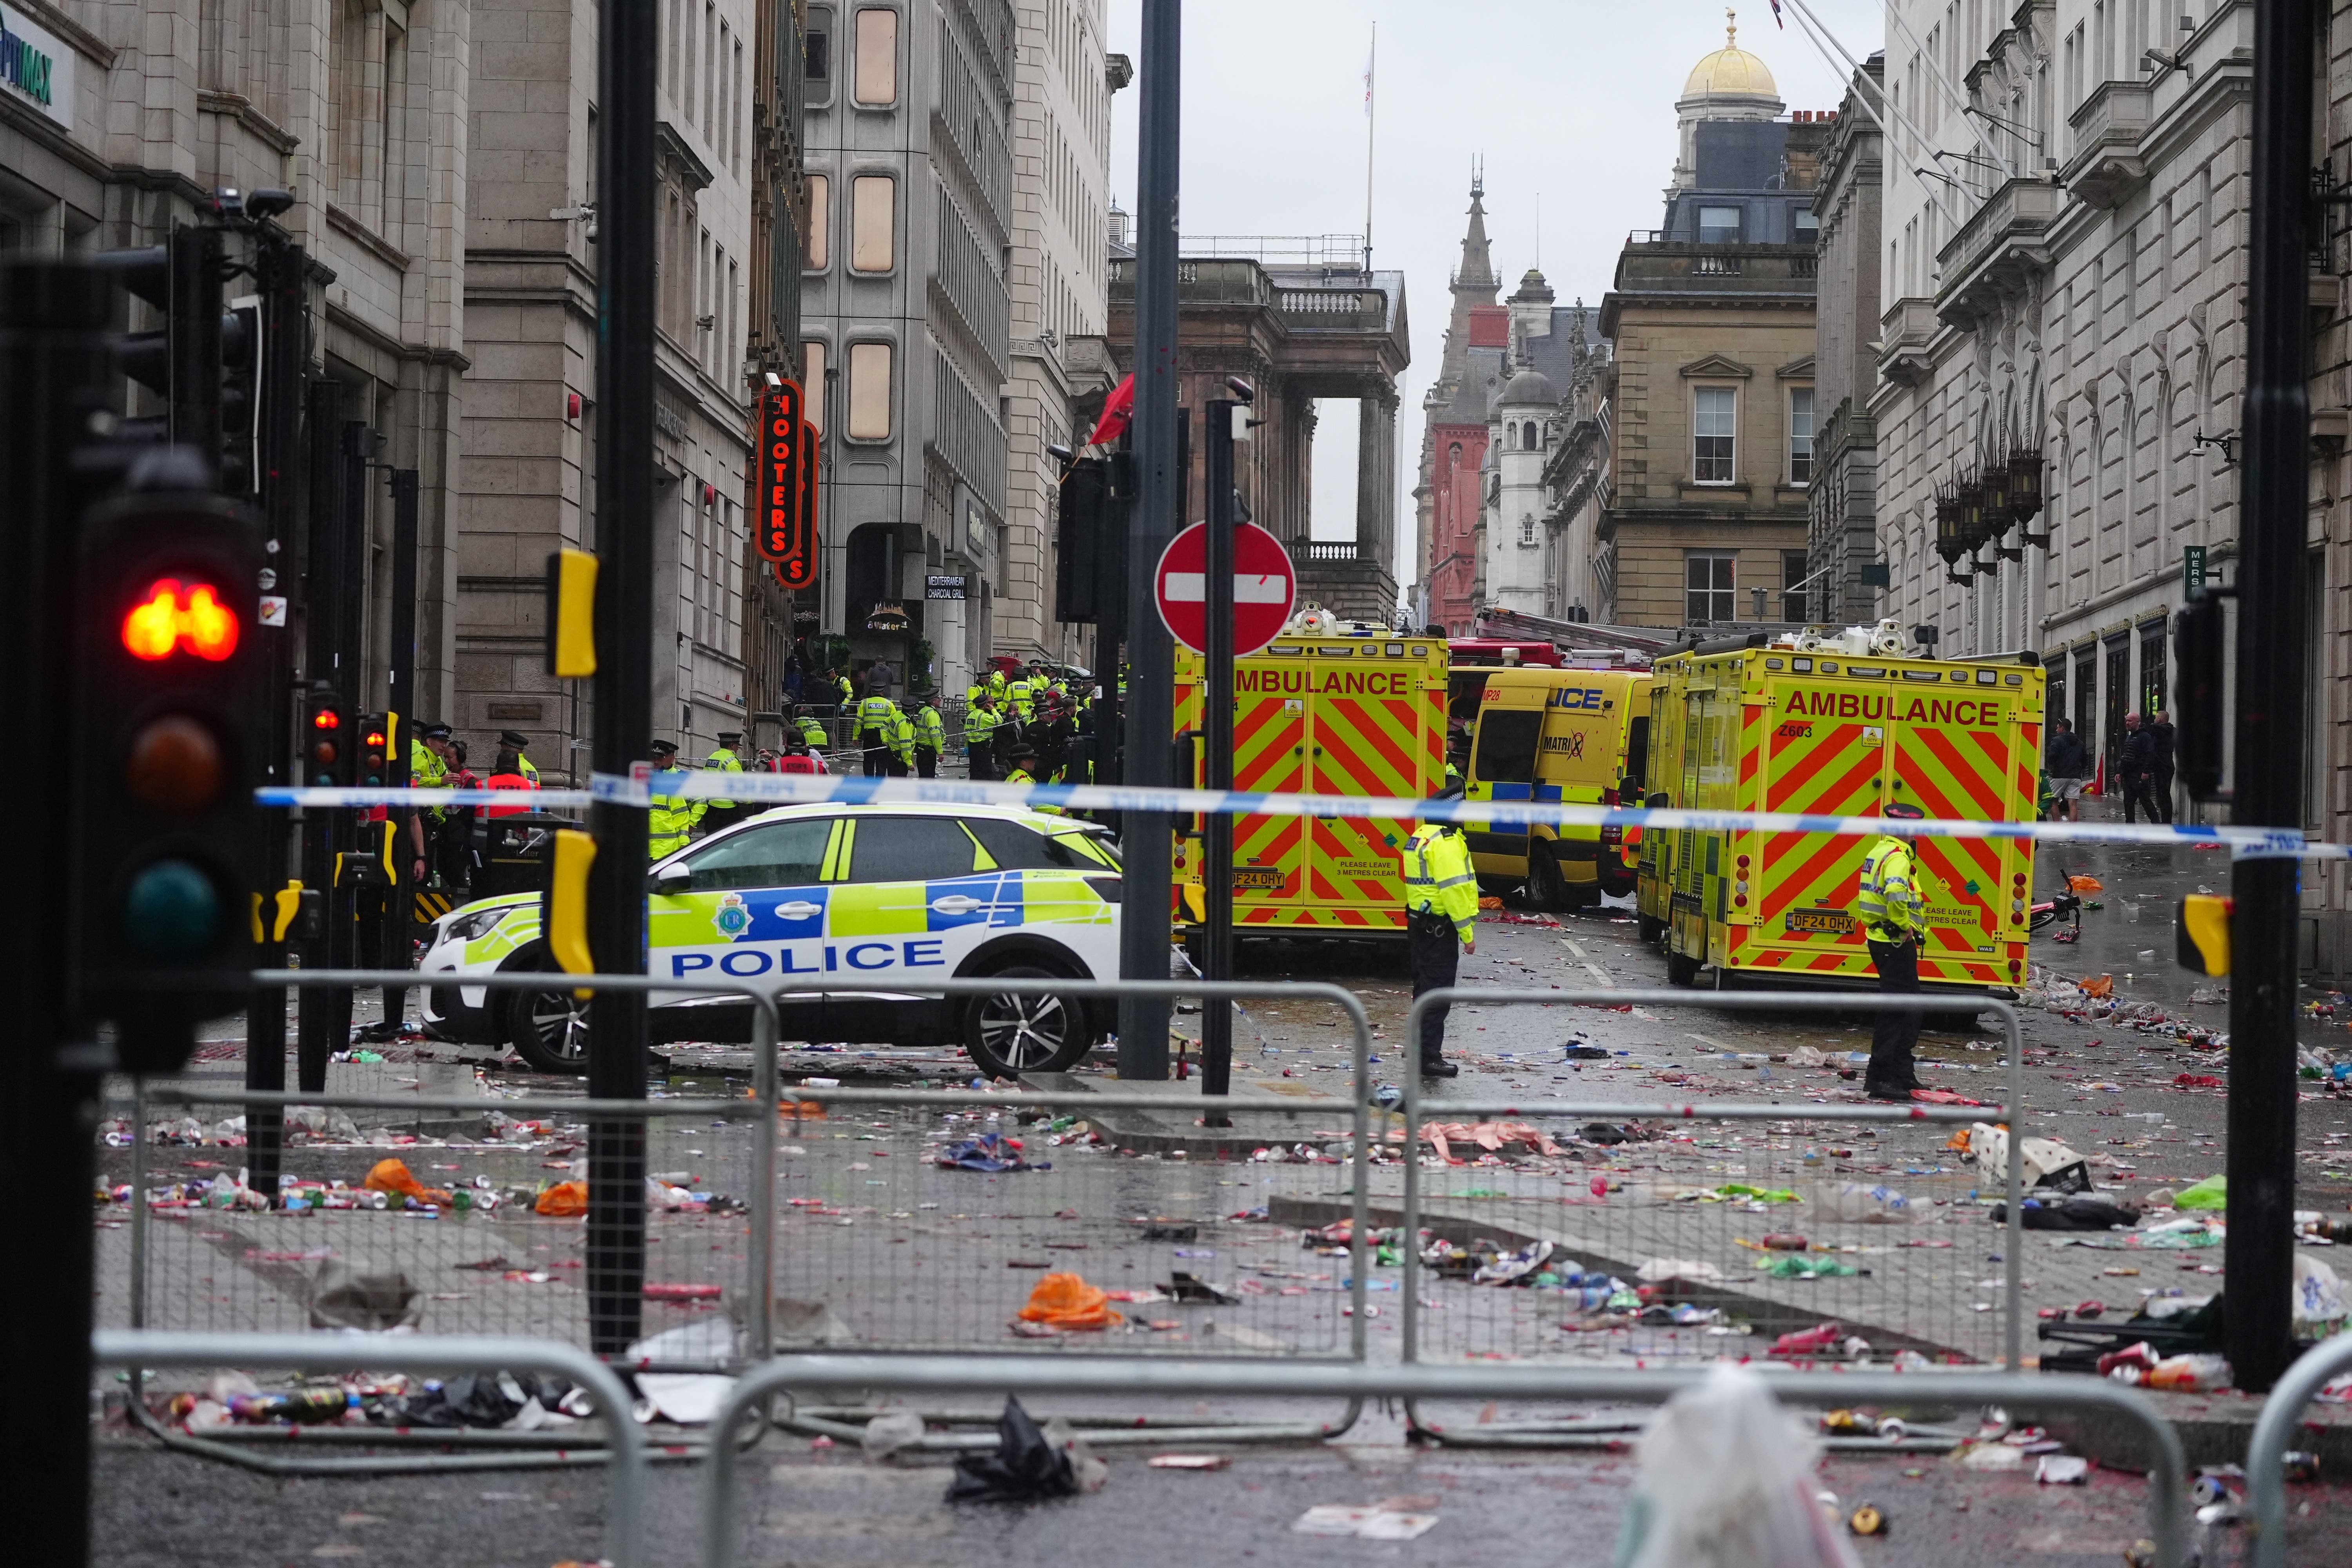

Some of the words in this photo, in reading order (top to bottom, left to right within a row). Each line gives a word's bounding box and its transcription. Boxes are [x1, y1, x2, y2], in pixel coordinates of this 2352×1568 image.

[0, 29, 53, 106] PTIMAX
[771, 395, 790, 551] HOOTERS
[928, 576, 964, 586] MEDITERRANEAN
[928, 589, 951, 598] CHARCOAL
[952, 589, 965, 598] GRILL
[875, 621, 900, 630] Water
[1236, 670, 1407, 695] MBULANCE
[1482, 690, 1501, 701] MP28
[1547, 688, 1603, 710] ICE
[1785, 690, 1999, 726] AMBULANCE
[1779, 725, 1812, 738] Z603
[1261, 874, 1283, 884] OHY
[1794, 915, 1825, 928] DF24
[1829, 917, 1853, 929] OHX
[671, 940, 945, 979] POLICE
